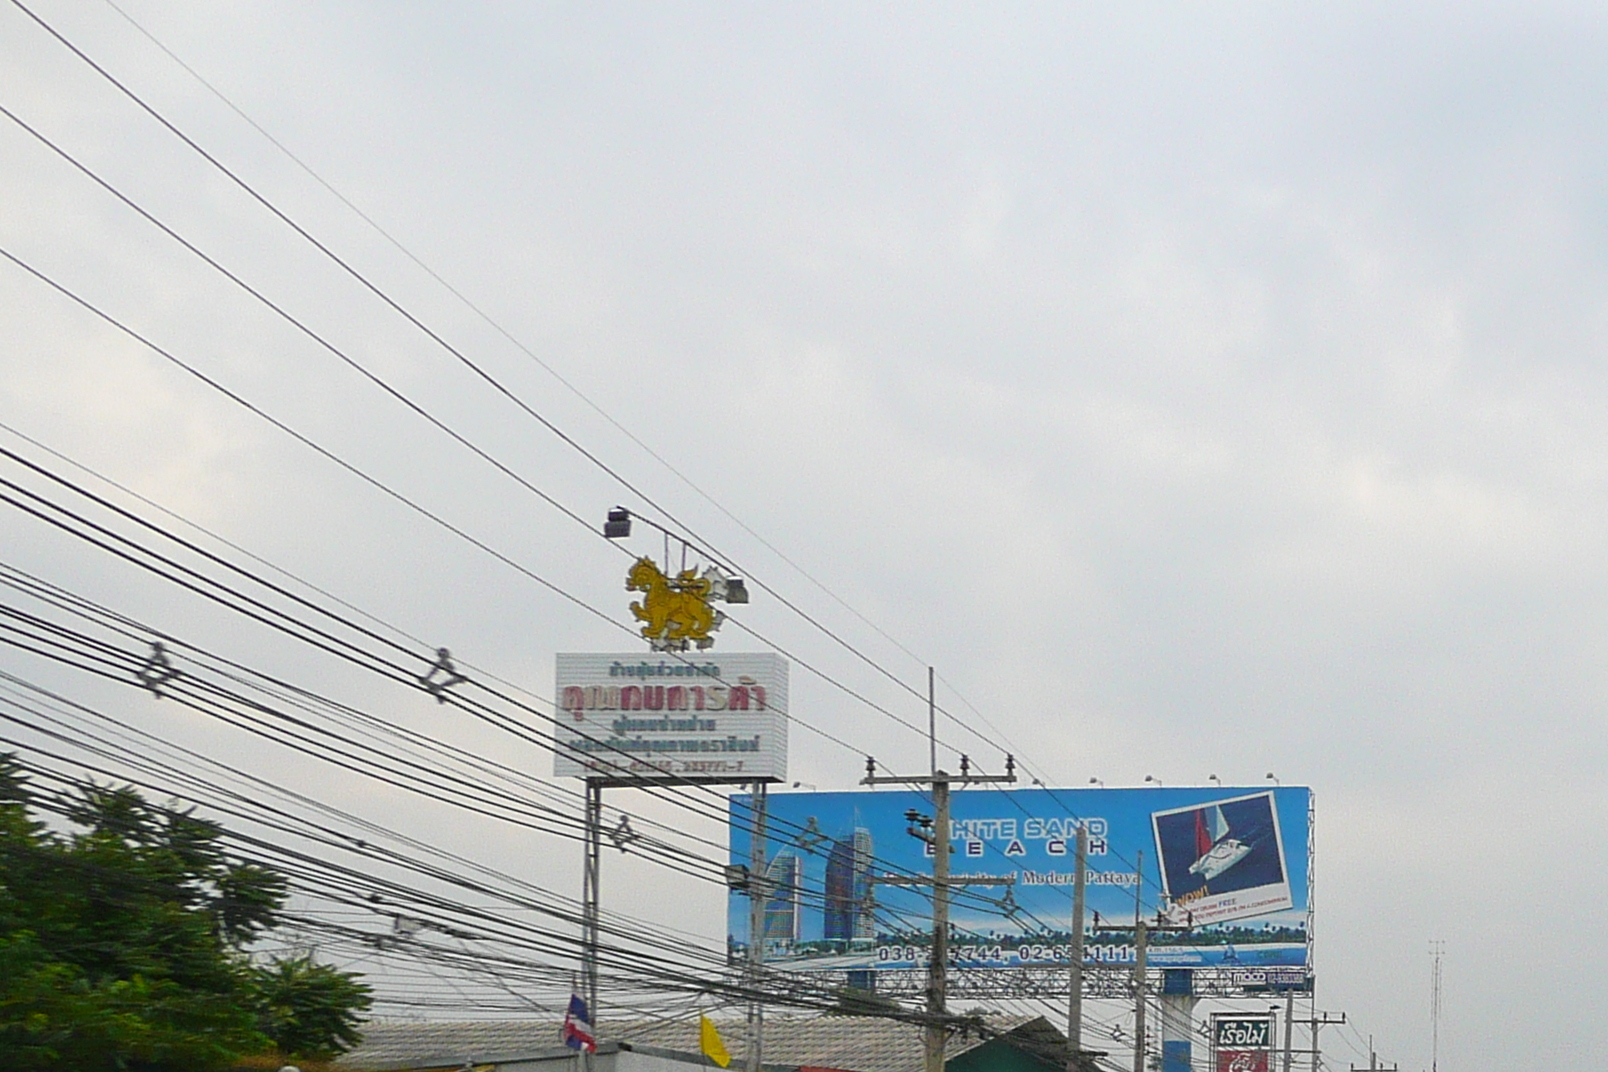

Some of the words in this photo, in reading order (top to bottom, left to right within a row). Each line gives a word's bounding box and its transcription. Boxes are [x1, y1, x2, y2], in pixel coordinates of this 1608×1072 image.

[933, 818, 1017, 841] HITE
[1023, 818, 1108, 839] SAND
[1219, 1021, 1267, 1044] เรือไม้
